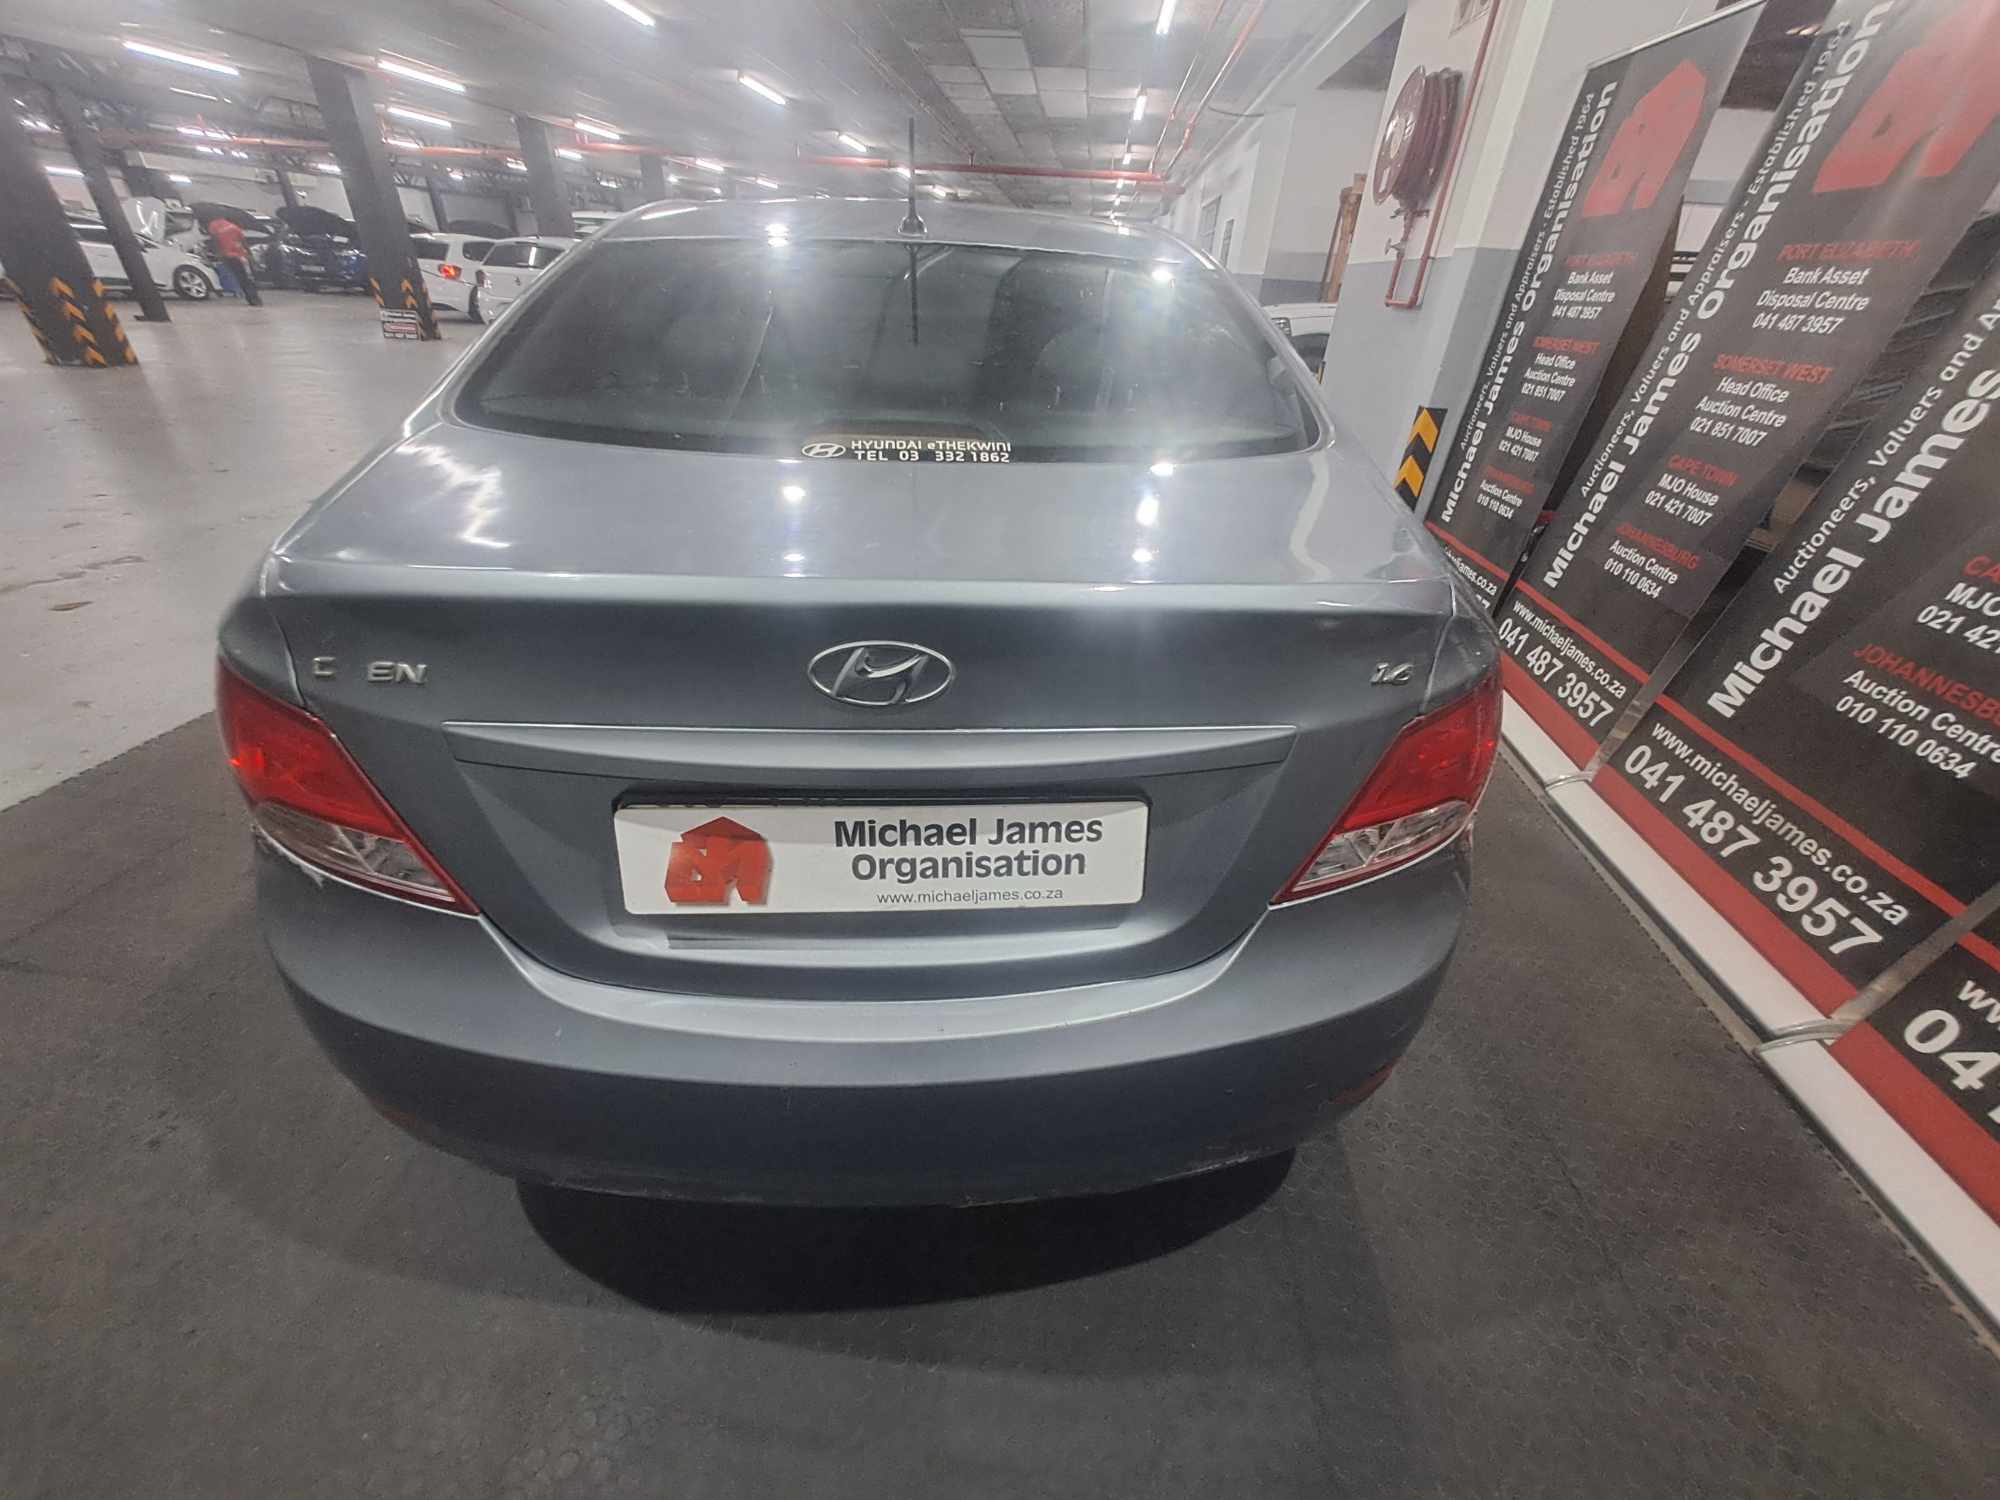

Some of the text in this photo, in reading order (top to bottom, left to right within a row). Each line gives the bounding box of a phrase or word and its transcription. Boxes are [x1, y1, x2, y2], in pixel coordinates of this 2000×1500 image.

[1486, 331, 1509, 376] Valuers
[1505, 303, 1518, 330] and
[1515, 231, 1545, 302] Appraisers
[1544, 135, 1579, 219] Established
[1575, 93, 1594, 131] 1964
[1580, 21, 1850, 497] Auctioneers, Valuers and Appraisers Established 1964
[1783, 266, 1872, 286] Bank Asset
[1440, 420, 1488, 523] Michael
[1483, 321, 1525, 416] James
[1521, 81, 1618, 312] Organisation
[1544, 1, 1895, 588] Michael James Organisation
[1586, 289, 1615, 302] Centre
[1756, 290, 1870, 311] Disposal Centre
[1752, 312, 1845, 334] 041 487 3957
[1524, 367, 1575, 387] Auction Centre
[1535, 353, 1576, 370] Head Office
[1783, 362, 1833, 385] WEST
[1716, 376, 1790, 403] Head Office
[1696, 395, 1787, 427] Auction Centre
[851, 440, 922, 450] HYUNDAI
[1690, 416, 1767, 447] 021 851 7007
[854, 450, 889, 462] TEL
[935, 450, 966, 462] 332
[972, 450, 1011, 464] 1862
[1773, 475, 1877, 594] Auctioneers,
[1867, 385, 1944, 467] Valuers
[1939, 332, 1984, 381] and
[1658, 473, 1719, 506] MJO House
[1645, 490, 1712, 527] 021 421 7007
[1707, 369, 2000, 718] Michael James
[1604, 558, 1663, 600] 010 110 0634
[1609, 540, 1679, 585] Auction Centre
[1917, 605, 1967, 634] 021
[1512, 600, 1627, 700] www.michaeljames.co.za
[1499, 618, 1614, 727] 041 487 3957
[1843, 669, 1932, 721] Auction
[1835, 695, 1977, 779] 010 110 0634
[834, 818, 1103, 848] Michael James
[1651, 722, 1910, 926] www.michaeljames.co.za
[851, 849, 1086, 884] Organisation
[1624, 744, 1884, 955] 041 487 3957
[876, 888, 1063, 904] www.michaeljames.co.za
